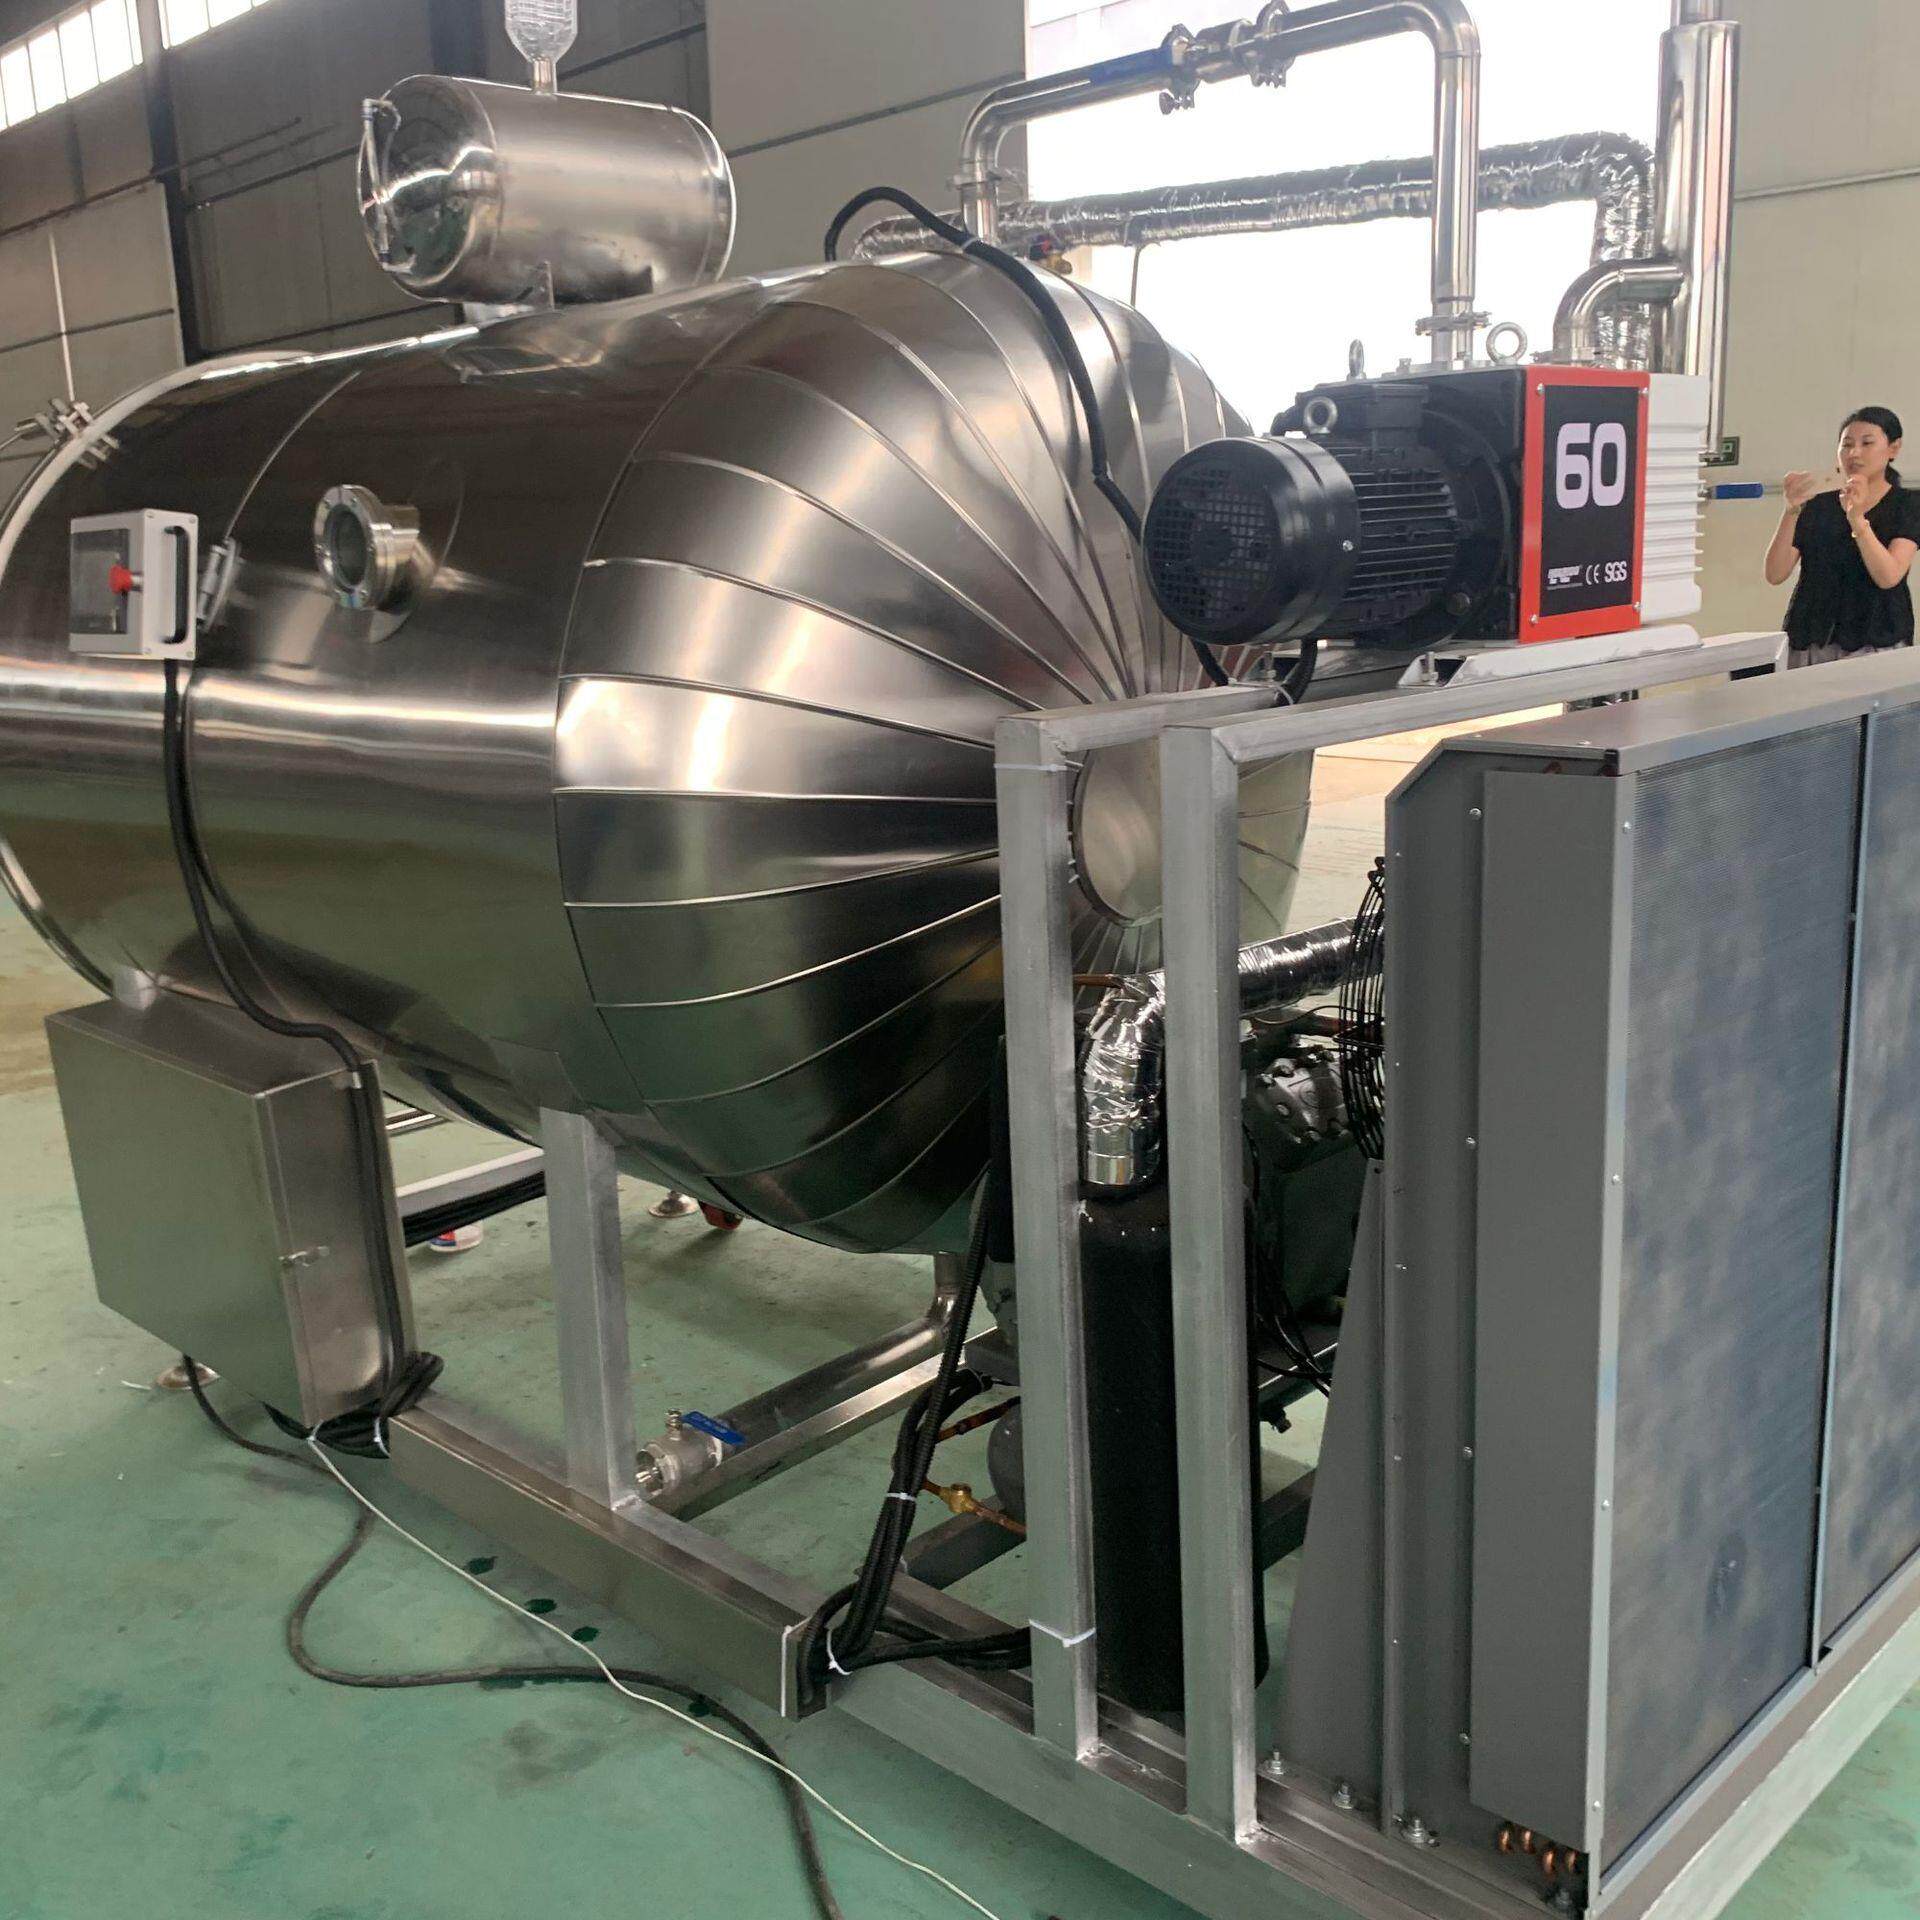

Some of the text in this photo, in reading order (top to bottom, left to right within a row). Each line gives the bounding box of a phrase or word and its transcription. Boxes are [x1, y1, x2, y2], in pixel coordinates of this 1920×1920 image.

[1556, 423, 1627, 509] 60
[1586, 564, 1600, 585] CE
[1604, 561, 1627, 583] SGS
